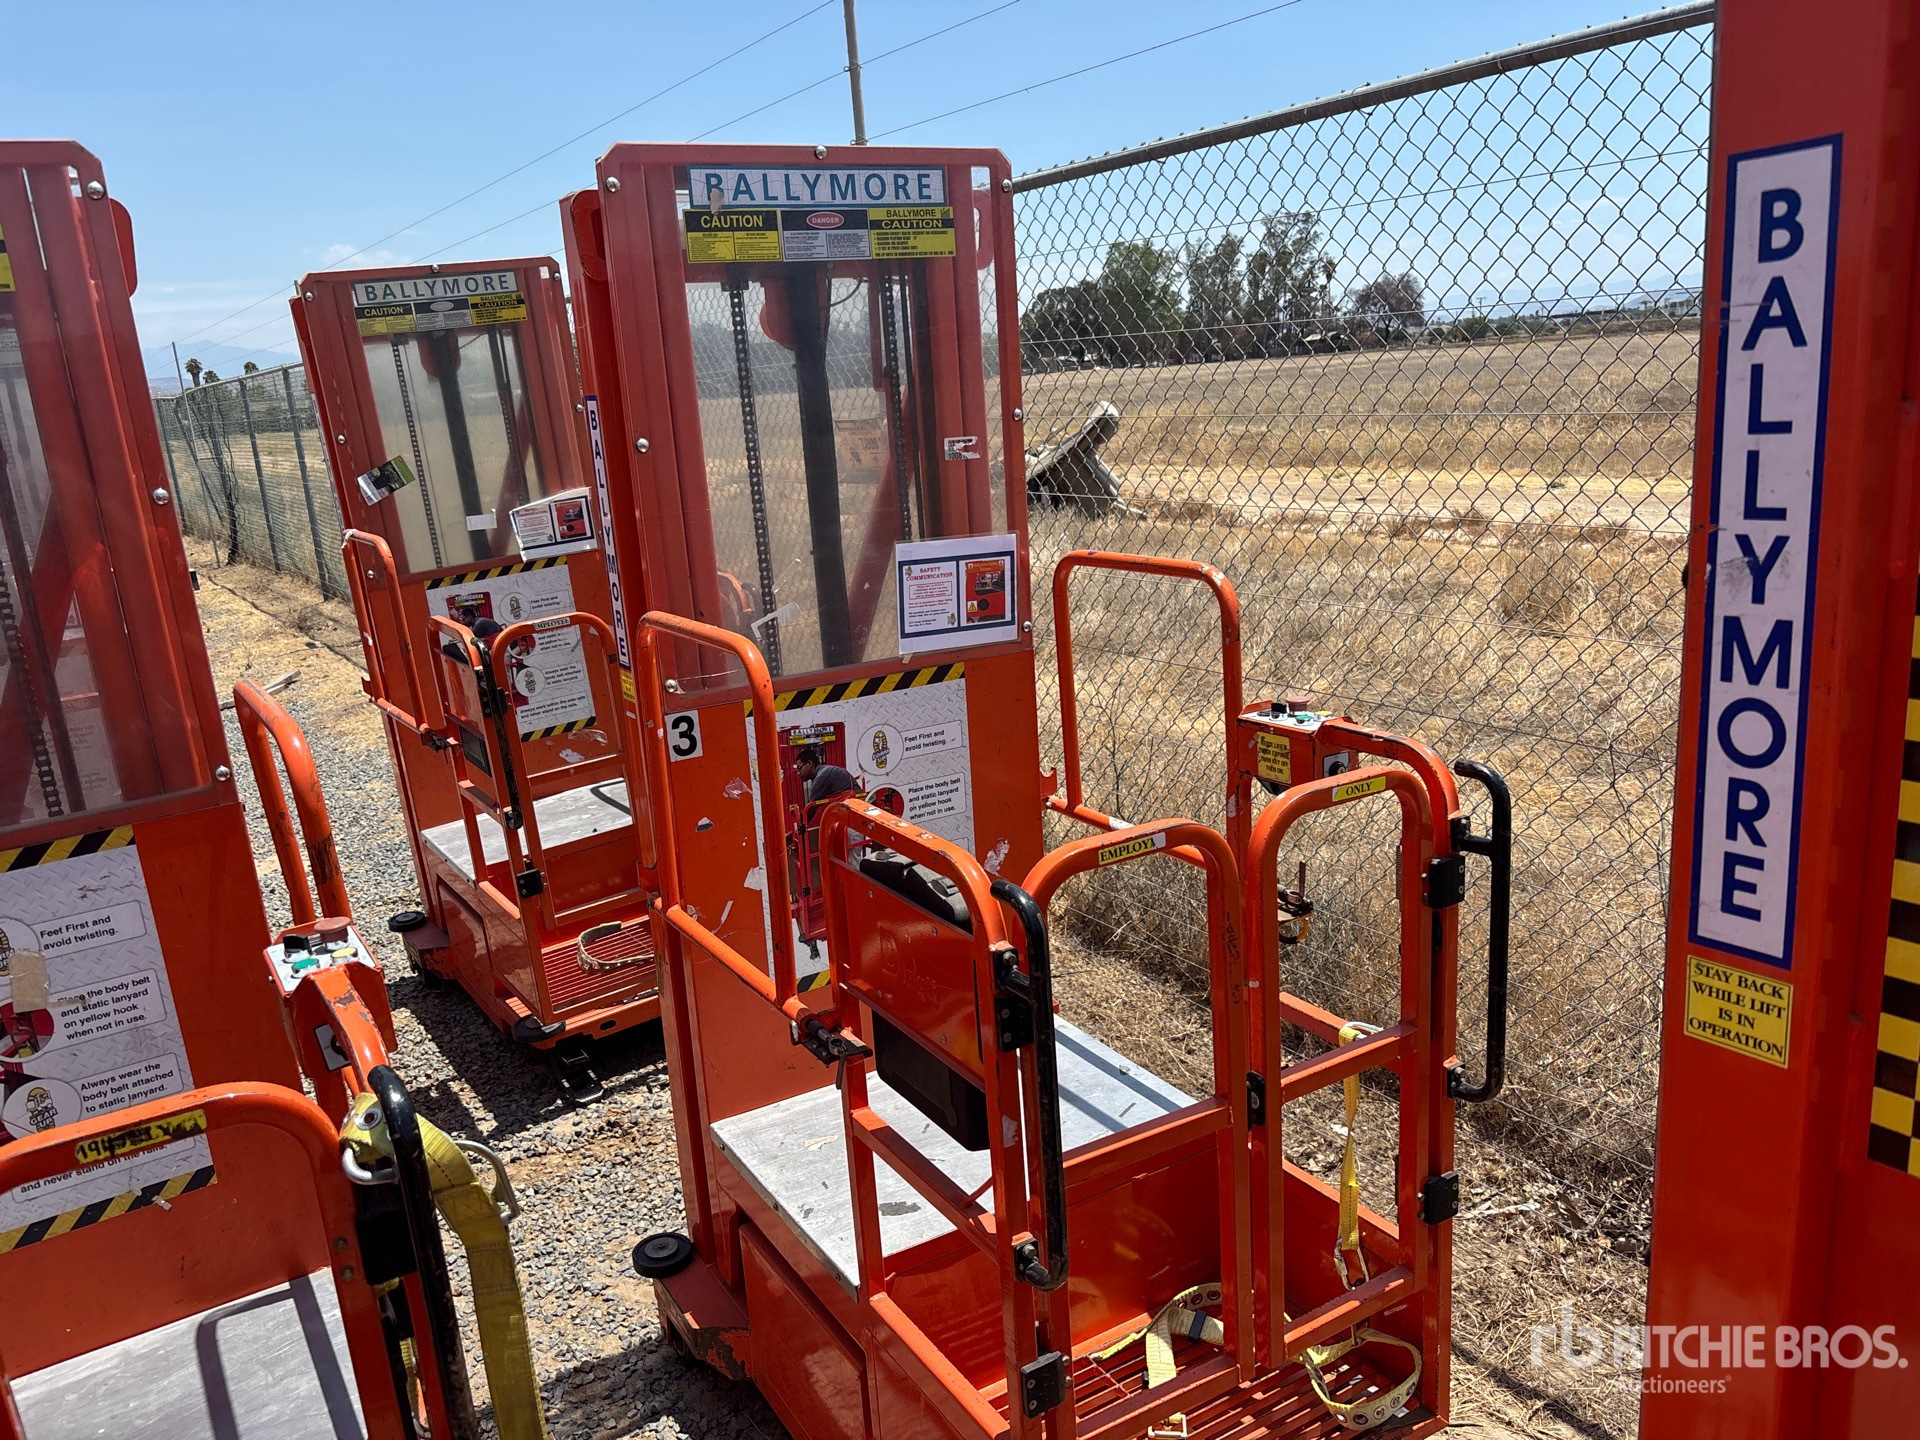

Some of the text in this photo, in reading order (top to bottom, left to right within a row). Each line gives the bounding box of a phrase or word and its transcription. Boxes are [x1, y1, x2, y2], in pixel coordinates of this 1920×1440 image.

[704, 172, 932, 201] BALLYMORE
[700, 214, 763, 229] CAUTION
[811, 216, 840, 224] DANGER
[881, 219, 942, 229] CAUTION
[886, 209, 937, 218] BALLYMORE
[364, 274, 510, 301] BALLYMORE
[364, 306, 404, 317] CAUTION
[477, 300, 518, 308] CAUTION
[590, 409, 627, 658] BALLYMORE
[1717, 187, 1808, 922] BALLYMORE
[671, 715, 698, 757] 3
[904, 729, 945, 743] Feet First and
[905, 743, 922, 752] avoid
[908, 777, 961, 794] Place the body belt
[908, 786, 959, 803] and static lanyard
[1345, 781, 1374, 796] ONLY
[909, 797, 952, 812] on yellow hook
[909, 812, 926, 820] when
[40, 915, 112, 939] Feet First and
[43, 927, 119, 951] avoid twisting.
[87, 988, 104, 1000] the
[104, 981, 130, 995] body
[131, 976, 151, 987] belt
[1694, 962, 1785, 1000] STAY BACK
[60, 988, 149, 1018] and static lanyard
[1692, 980, 1787, 1019] WHILE LIFT
[63, 1003, 139, 1029] on yellow hook
[66, 1014, 147, 1040] when not in use.
[1718, 1007, 1756, 1030] IS IN
[1689, 1016, 1784, 1058] OPERATION
[80, 1062, 161, 1091] Always wear the
[82, 1070, 174, 1104] body belt attached
[85, 1084, 168, 1113] to static lanyard.
[30, 1107, 58, 1126] GEAR
[20, 1181, 41, 1193] and
[43, 1172, 73, 1187] never
[75, 1162, 105, 1176] stand
[107, 1158, 121, 1167] on
